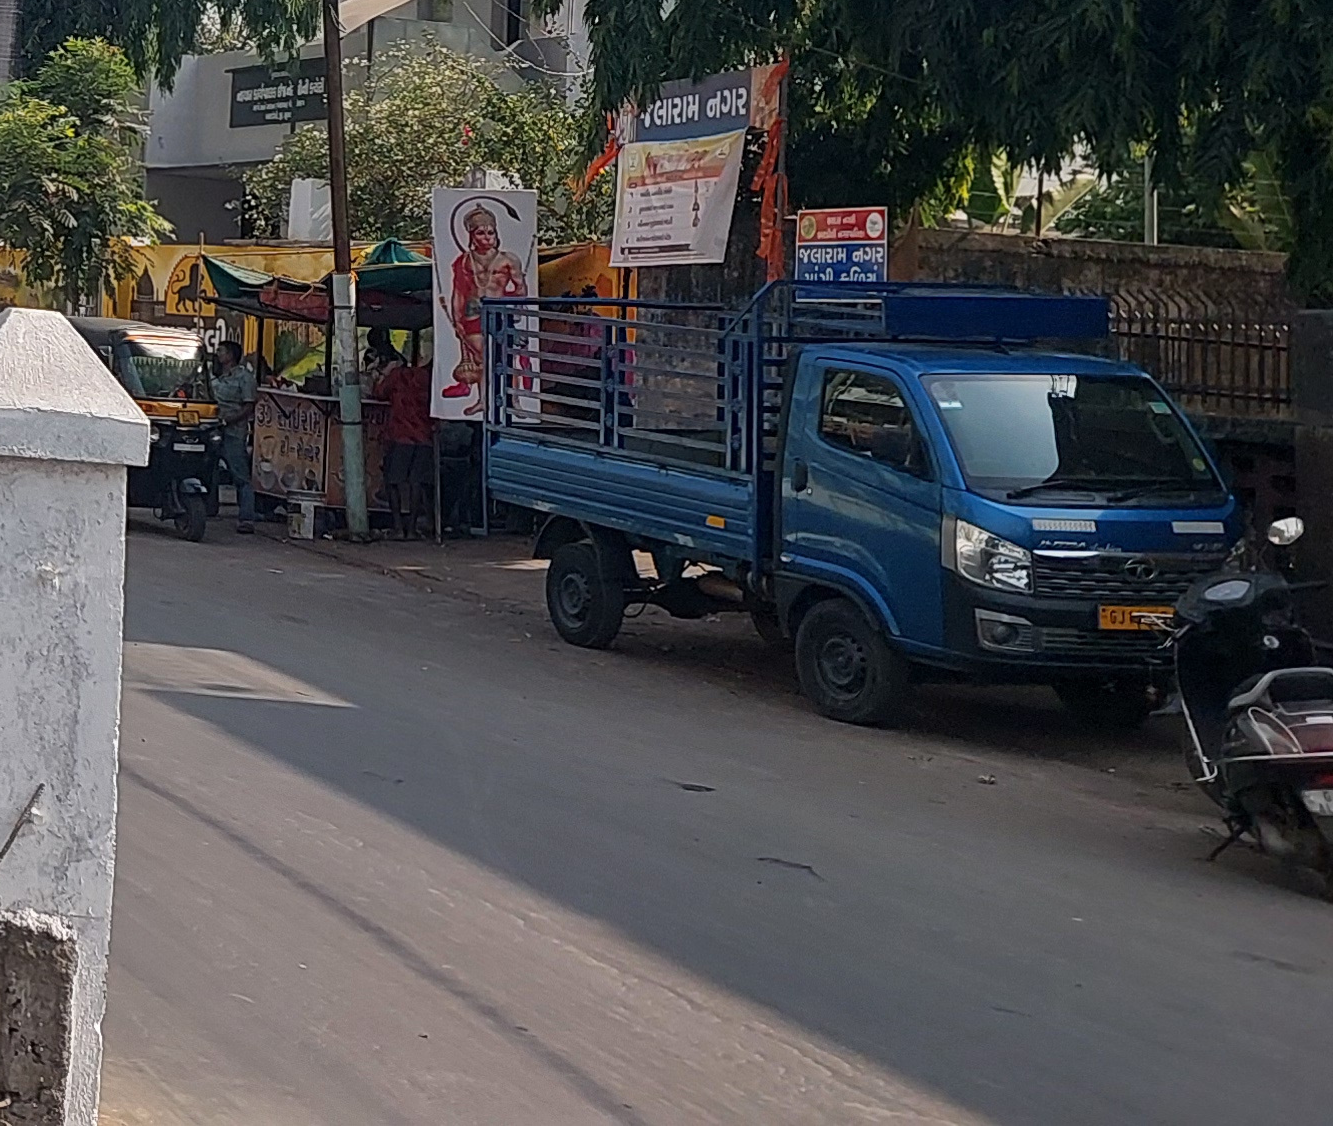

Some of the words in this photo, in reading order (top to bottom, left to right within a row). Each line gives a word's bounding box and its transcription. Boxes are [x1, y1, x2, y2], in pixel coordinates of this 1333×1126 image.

[706, 87, 748, 119] નગર
[799, 247, 847, 264] જલારામ
[852, 246, 885, 264] નગર
